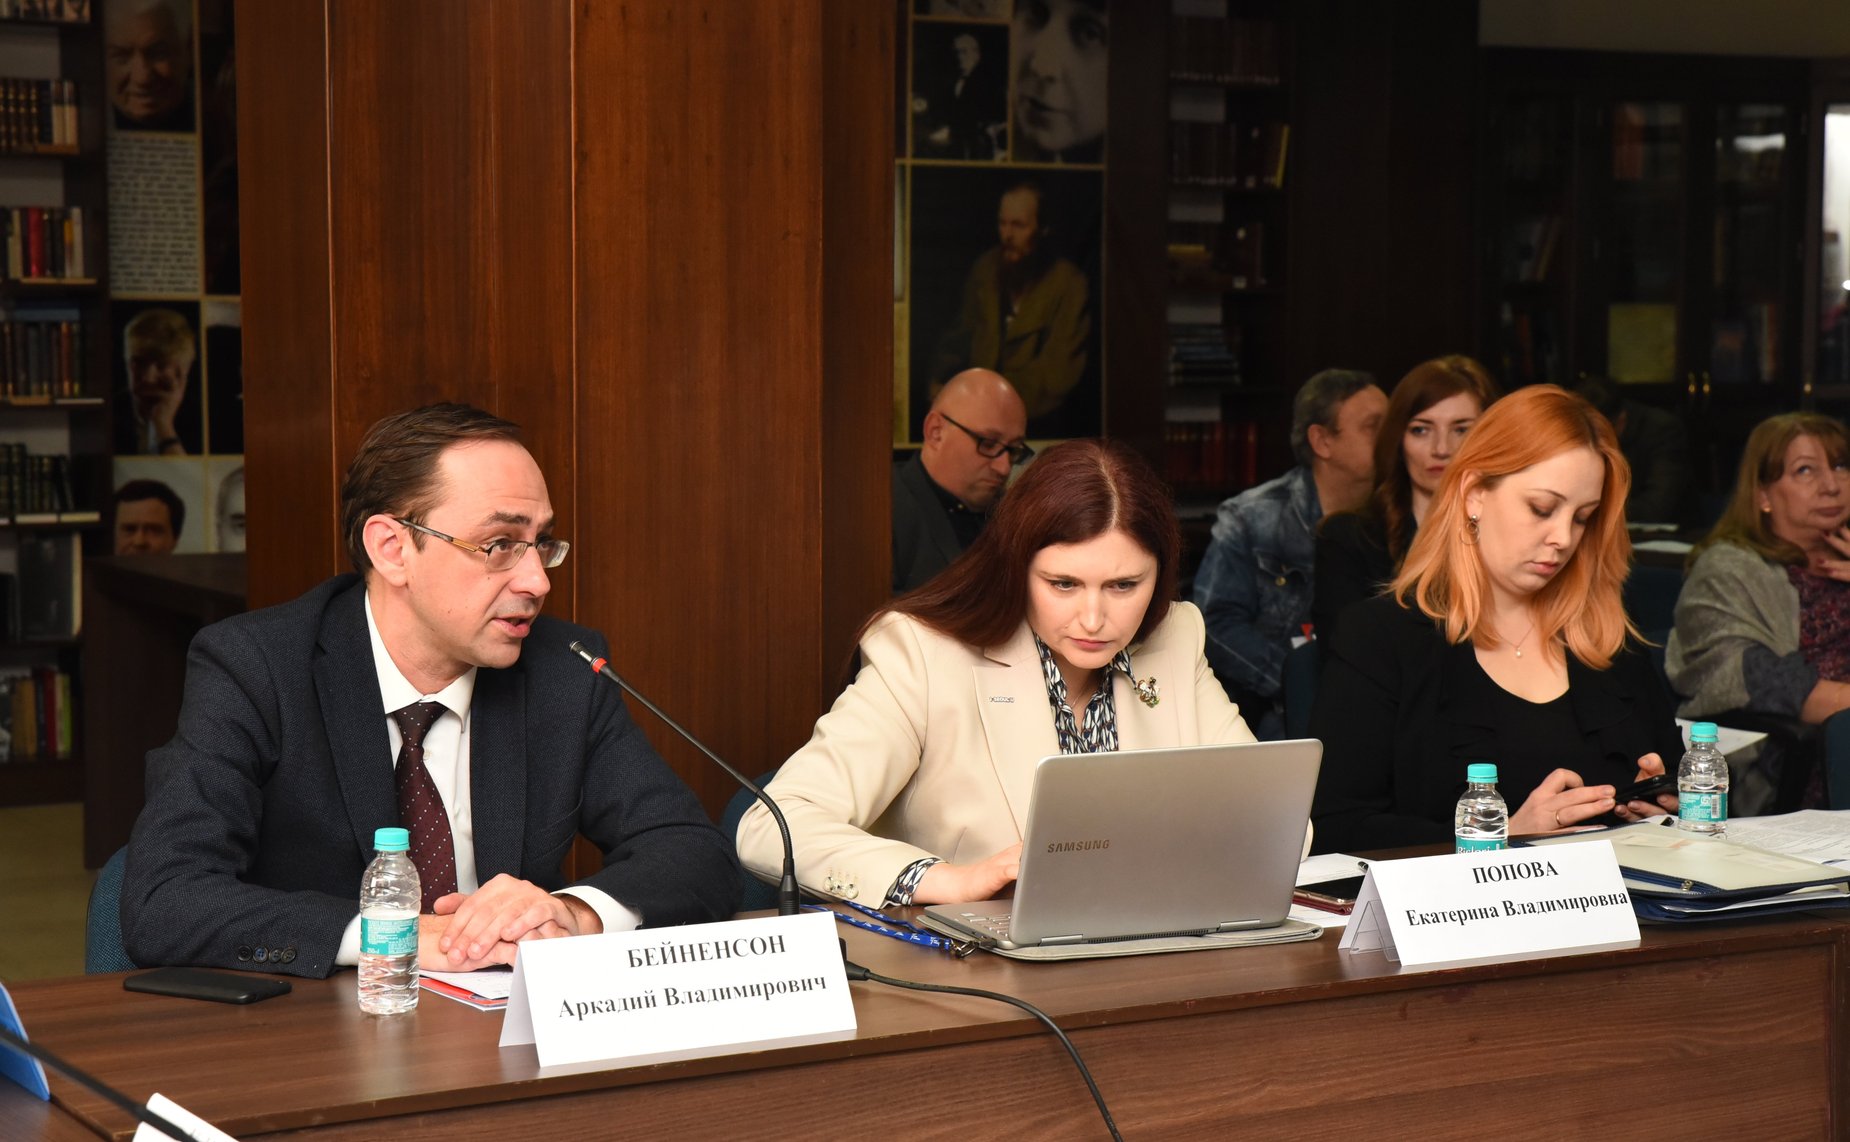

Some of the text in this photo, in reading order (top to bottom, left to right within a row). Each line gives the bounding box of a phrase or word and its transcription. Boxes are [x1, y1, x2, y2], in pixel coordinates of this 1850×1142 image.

[1047, 839, 1110, 853] SAMSUNG
[1472, 860, 1559, 884] ПОПОВА
[1405, 892, 1628, 927] Екатерина Владимировна
[627, 934, 786, 968] БЕЙНЕНСОН
[558, 976, 827, 1021] Аркадий Владимирович
